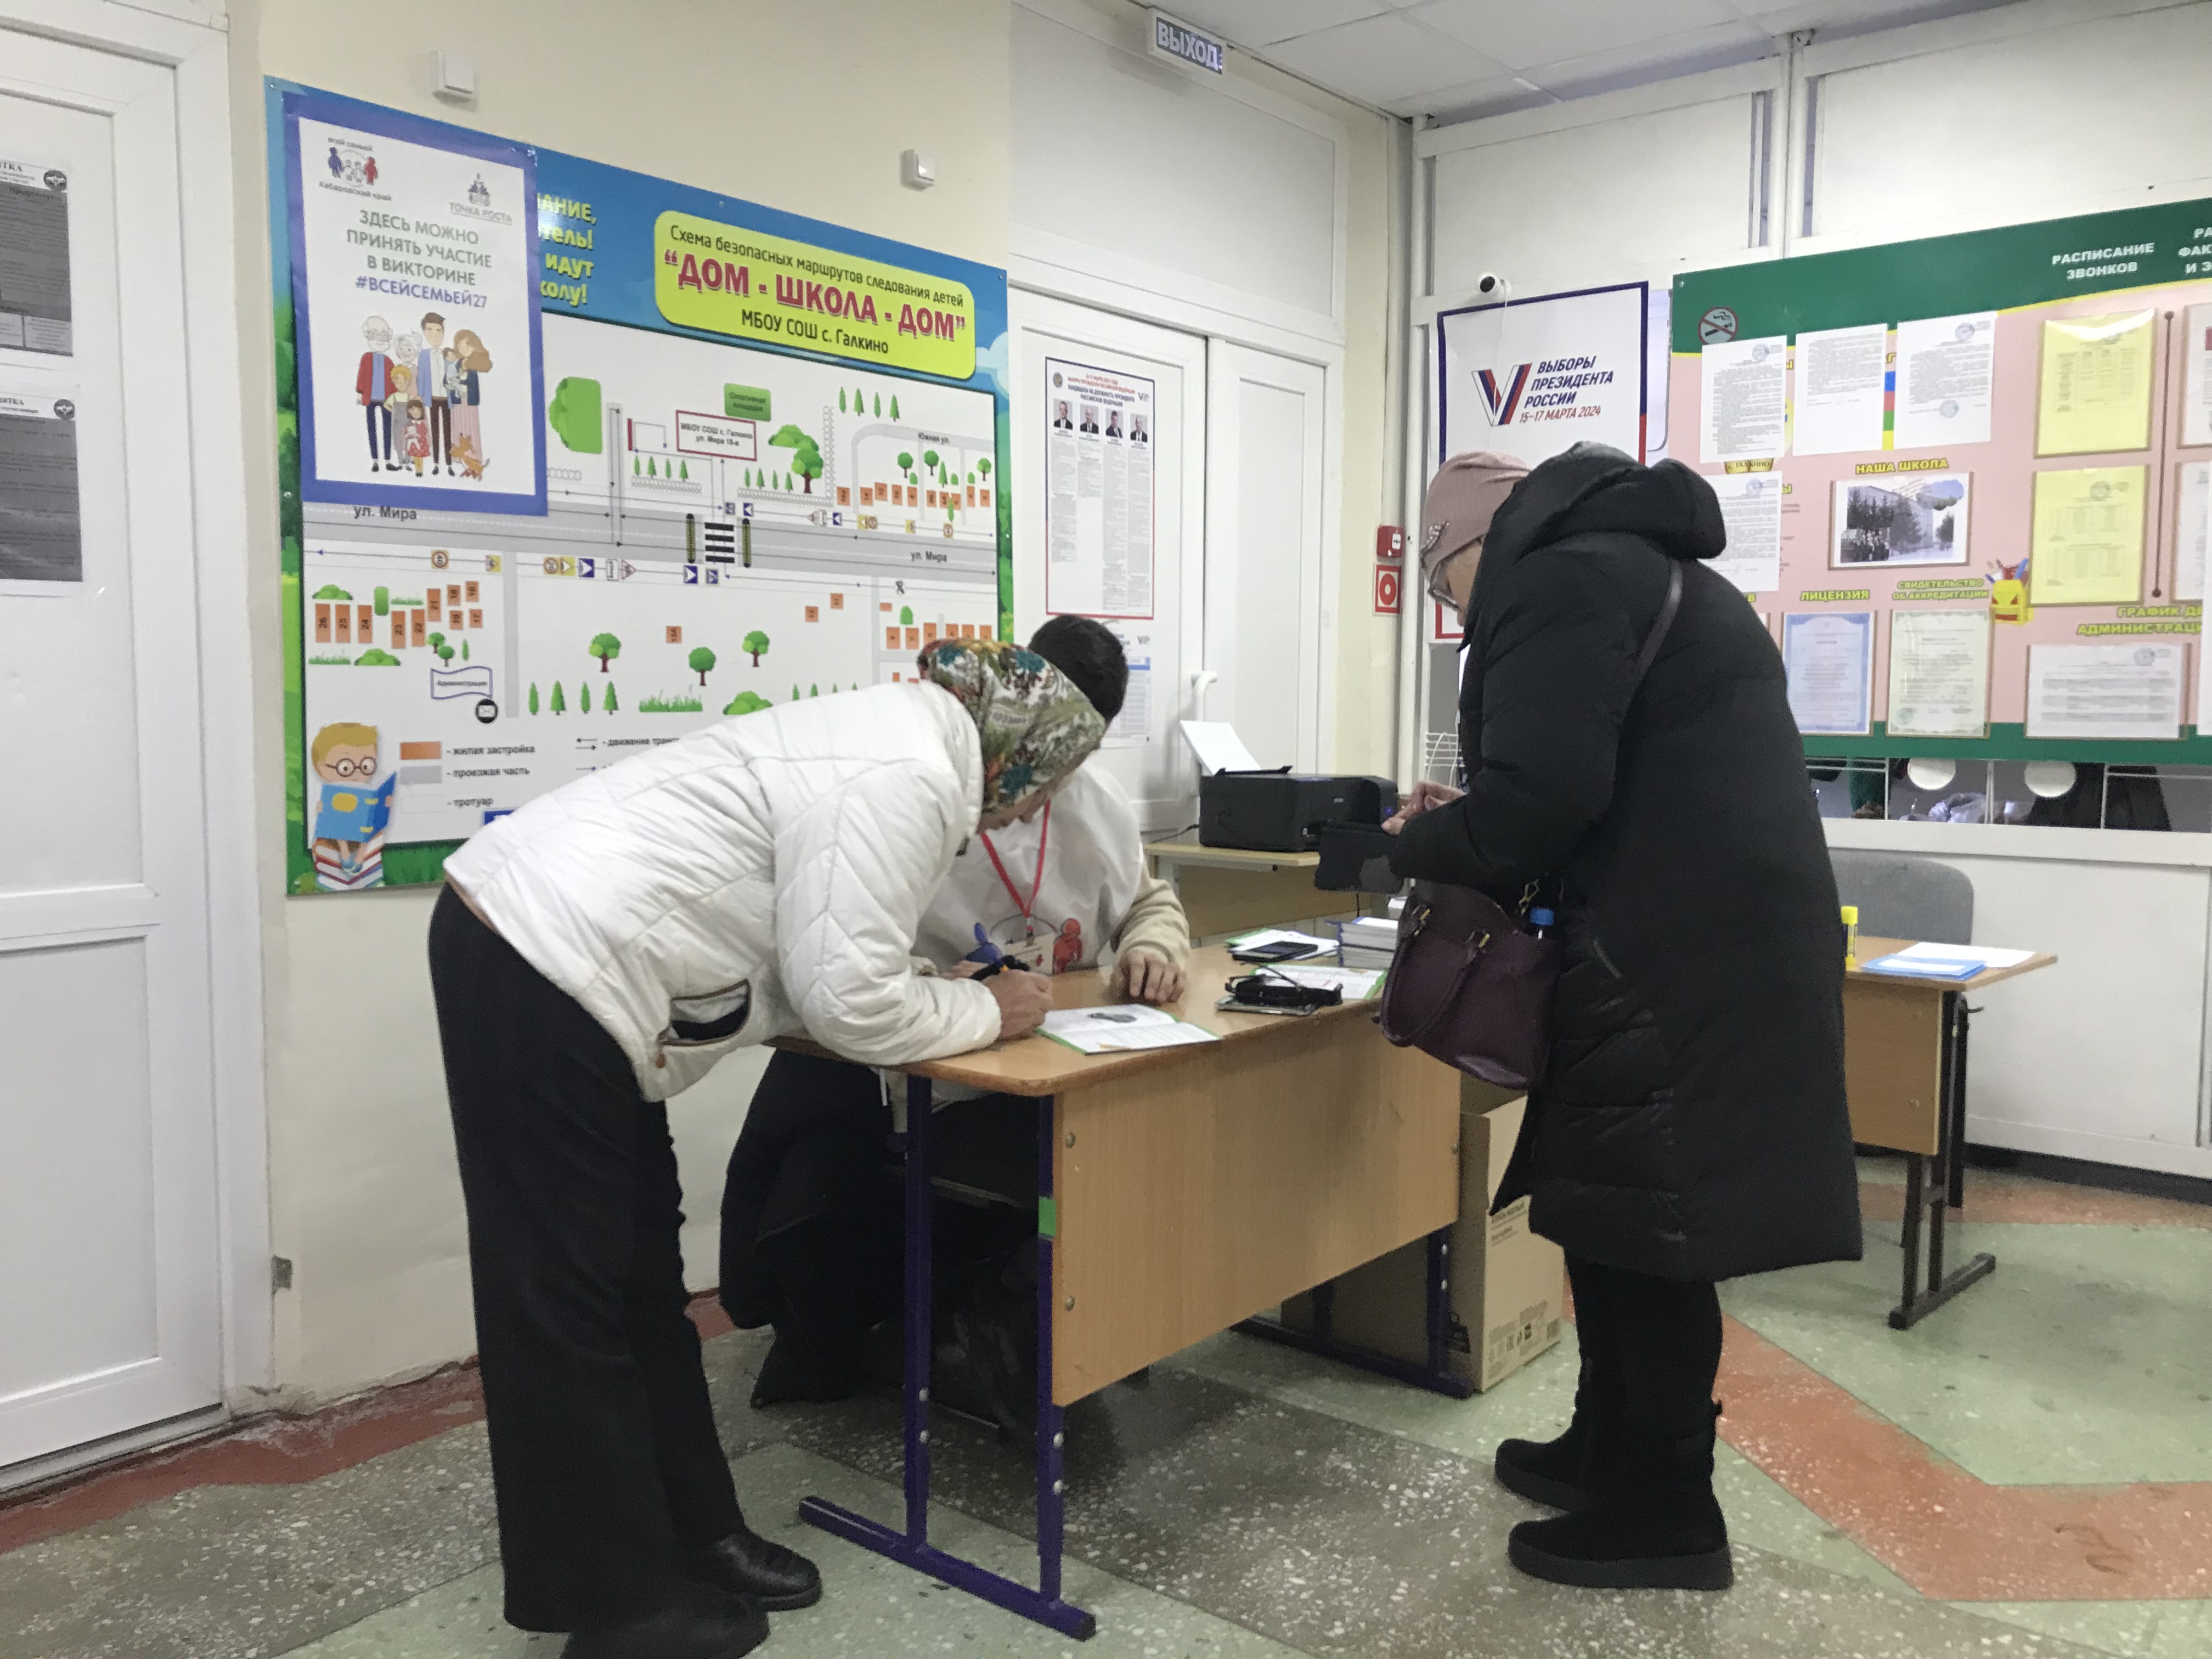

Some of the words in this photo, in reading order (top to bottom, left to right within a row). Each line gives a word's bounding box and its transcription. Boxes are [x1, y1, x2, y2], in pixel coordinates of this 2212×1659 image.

[1158, 21, 1219, 71] ВЫХОД
[450, 202, 478, 216] ТОЧКА
[482, 210, 512, 222] РОСТА
[360, 210, 410, 232] ЗДЕСЬ
[415, 220, 478, 244] МОЖНО
[347, 229, 421, 255] ПРИНЯТЬ
[425, 244, 492, 268] УЧАСТИЕ
[2052, 242, 2155, 265] РАСПИСАНИЕ
[367, 255, 377, 269] В
[382, 257, 476, 286] ВИКТОРИНЕ
[670, 224, 712, 248] Схема
[715, 236, 793, 267] безопасных
[797, 258, 862, 282] маршрутов
[866, 275, 930, 300] следования
[933, 291, 963, 307] детей
[2066, 261, 2138, 280] ЗВОНКОВ
[355, 276, 487, 308] #ВСЕЙСЕМЬЕЙ27
[776, 274, 878, 325] ШКОЛА
[742, 309, 782, 331] МБОУ
[787, 318, 817, 339] СОШ
[822, 329, 832, 342] с.
[836, 329, 889, 354] Галкино
[1537, 356, 1596, 374] ВЫБОРЫ
[1530, 371, 1613, 391] ПРЕЗИДЕНТА
[1524, 391, 1577, 408] РОССИИ
[1544, 408, 1576, 421] МАРТА
[1578, 405, 1601, 417] 2024
[1855, 462, 1895, 475] НАША
[1898, 459, 1949, 472] ШКОЛА
[354, 506, 374, 518] ул.
[380, 506, 417, 522] Мира
[1897, 578, 1984, 589] СВИДЕТЕЛЬСТВО
[1800, 589, 1870, 602] ЛИЦЕНЗИЯ
[1892, 592, 1906, 600] ОБ
[2117, 606, 2181, 618] ГРАФИК
